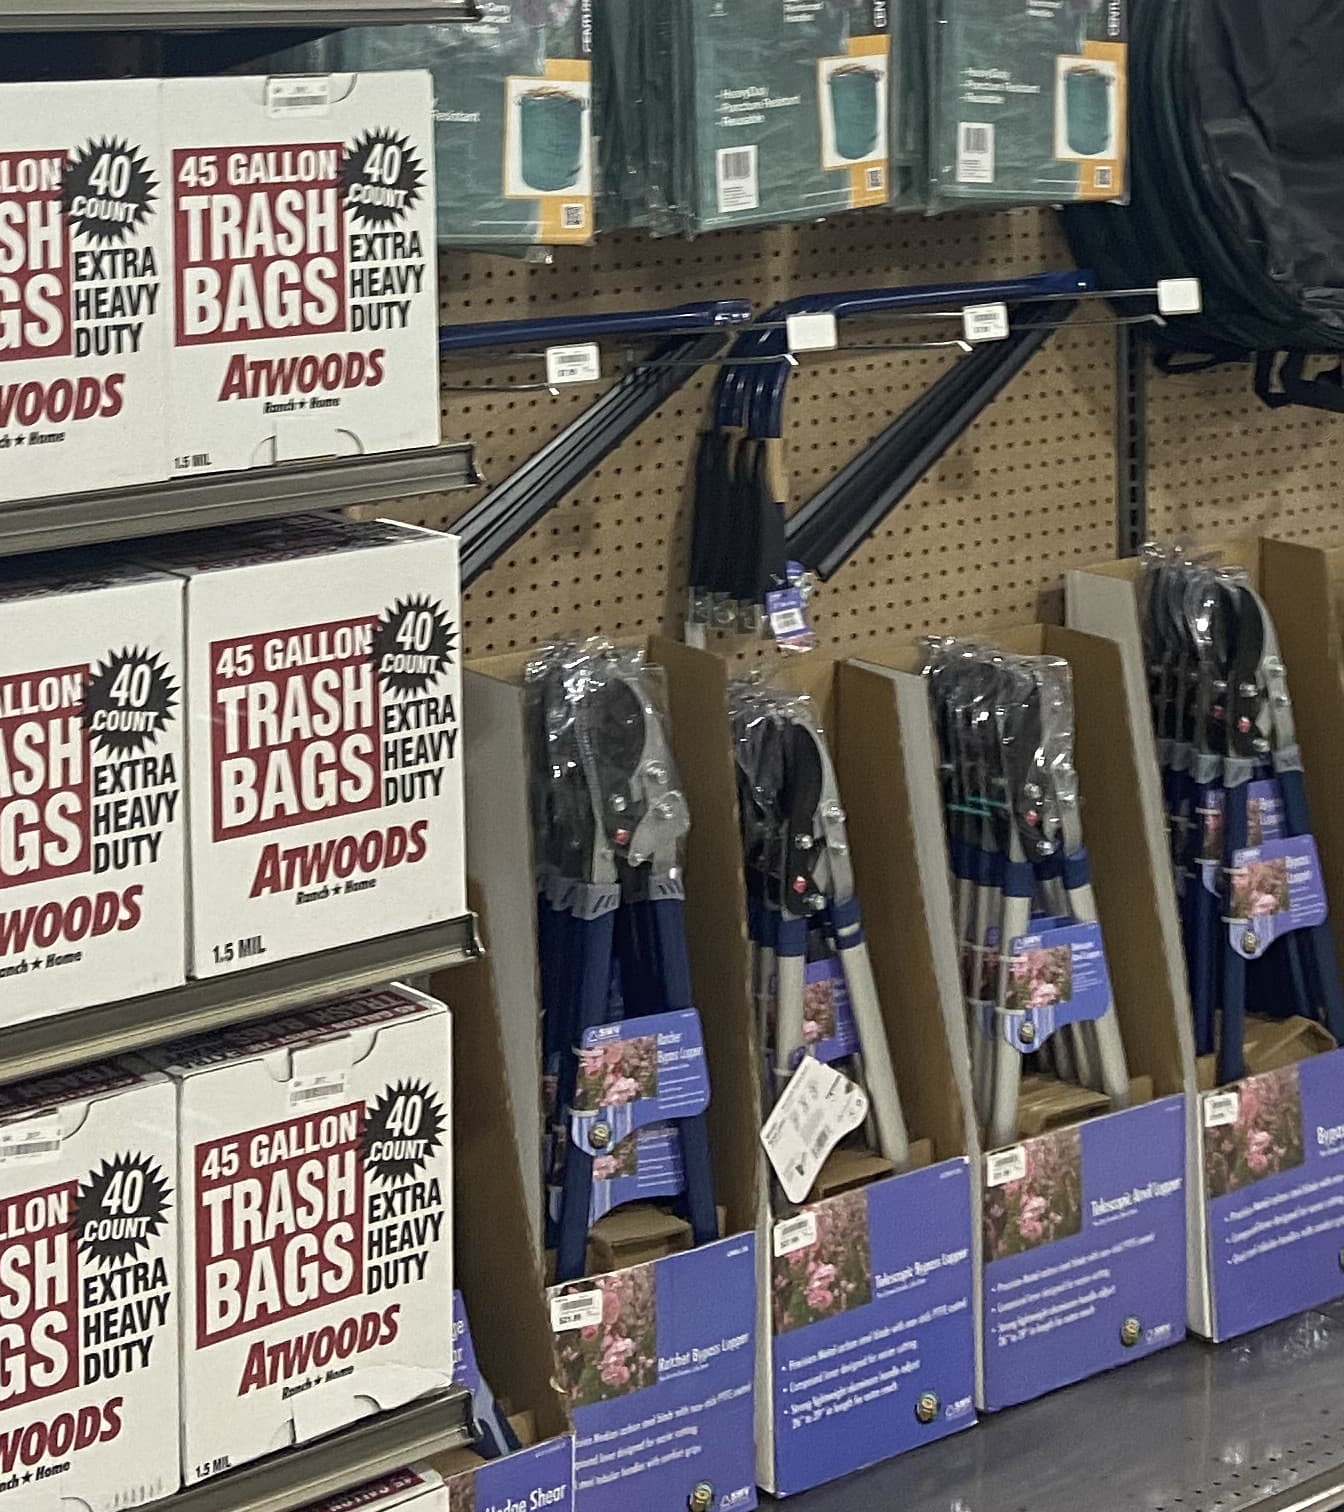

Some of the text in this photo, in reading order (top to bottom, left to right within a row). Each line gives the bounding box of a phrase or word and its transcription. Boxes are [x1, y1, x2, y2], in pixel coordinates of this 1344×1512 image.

[179, 149, 336, 187] 45 GALLON
[364, 144, 401, 184] 40
[349, 183, 408, 209] COUNT
[179, 189, 337, 263] TRASH
[350, 230, 422, 263] EXTRA
[184, 258, 339, 336] BAGS
[350, 264, 425, 299] HEAVY
[351, 300, 411, 333] DUTY
[217, 349, 385, 402] ATWOODS
[110, 662, 152, 709] 40
[91, 708, 158, 732] COUNT
[95, 753, 175, 795] EXTRA
[95, 790, 179, 835] HEAVY
[95, 831, 163, 873] DUTY
[47, 949, 82, 968] Home
[101, 1167, 145, 1217] 40
[83, 1215, 152, 1244] COUNT
[84, 1256, 168, 1310] EXTRA
[84, 1291, 172, 1349] HEAVY
[84, 1335, 154, 1386] DUTY
[35, 1460, 71, 1481] Home
[529, 1483, 568, 1511] Shear
